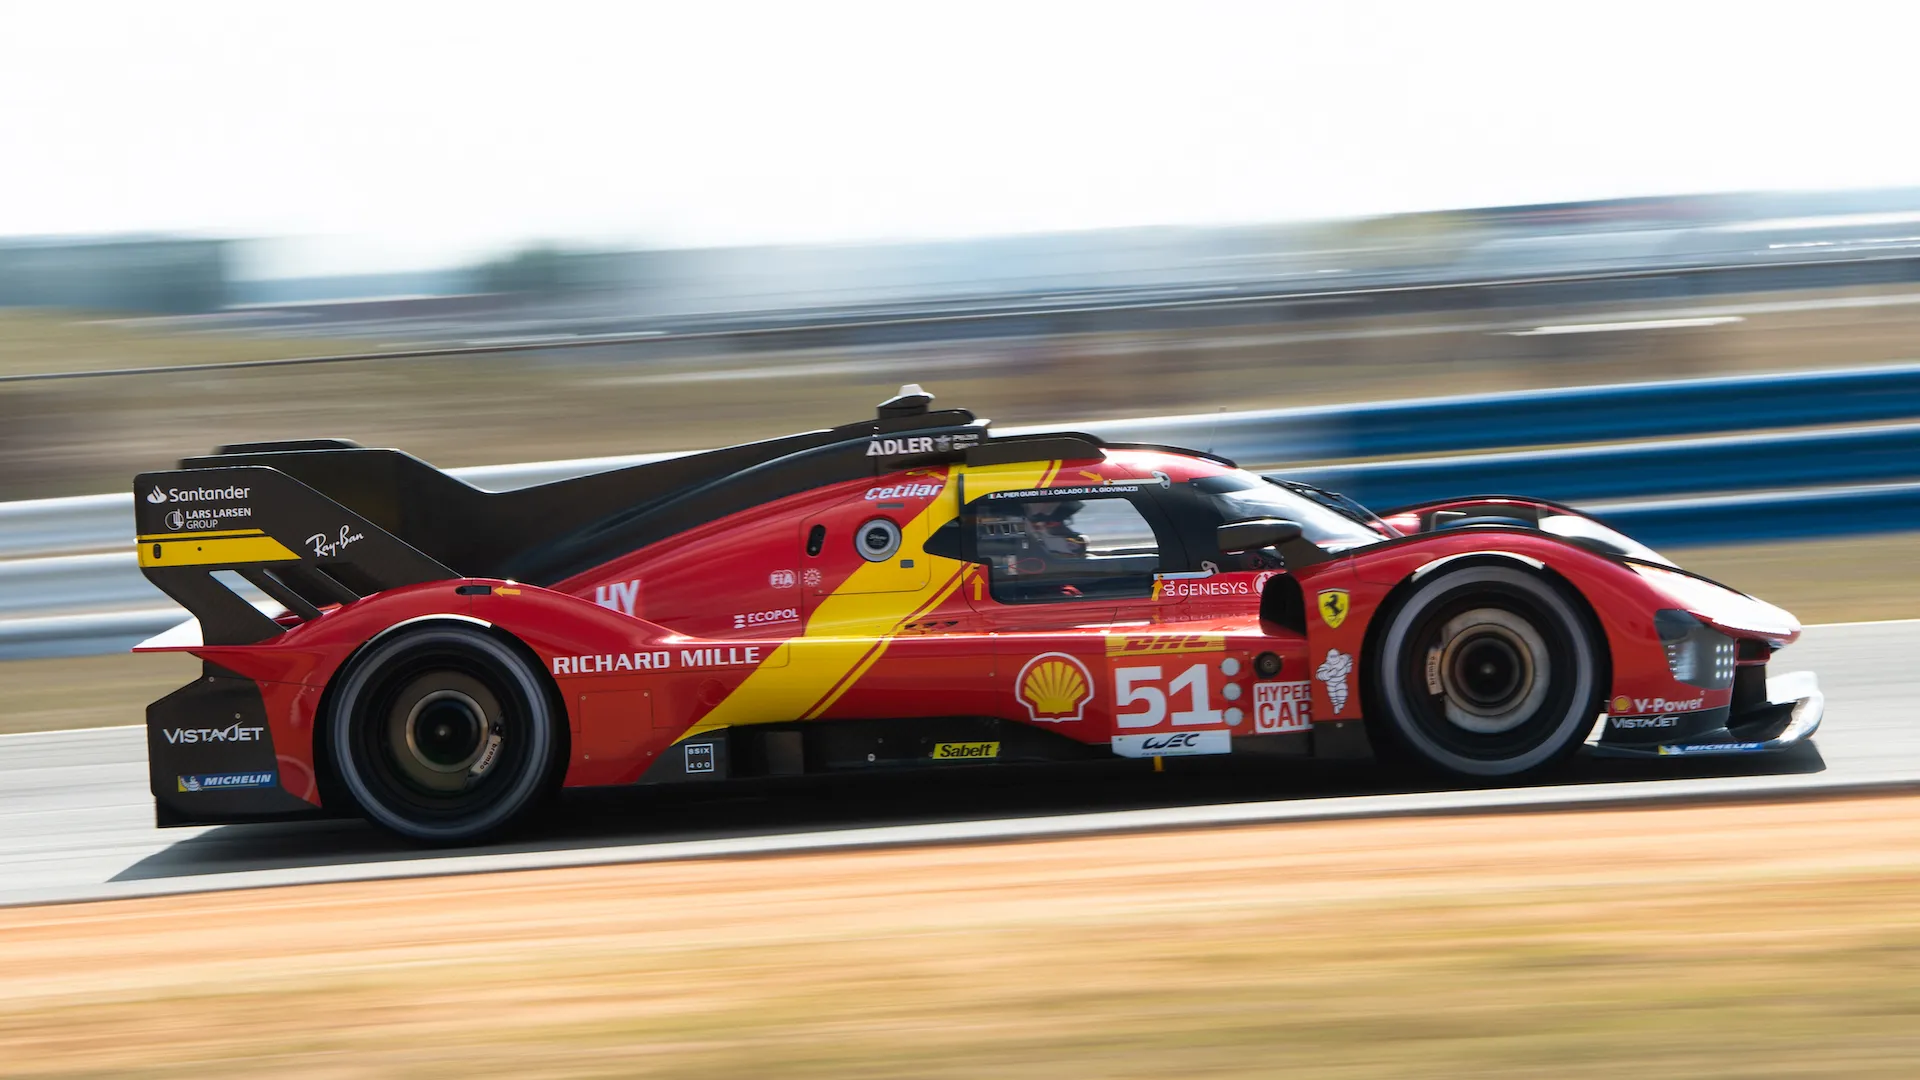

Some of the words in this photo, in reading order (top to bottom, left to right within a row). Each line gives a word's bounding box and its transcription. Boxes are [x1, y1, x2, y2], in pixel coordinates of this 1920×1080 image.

[866, 436, 934, 456] ADLER
[168, 485, 251, 503] Santander
[185, 509, 212, 519] LARS
[212, 507, 252, 518] LARSEN
[185, 519, 218, 530] GROUP
[1178, 582, 1249, 597] GENESYS
[747, 608, 799, 623] ECOPOL
[552, 651, 670, 675] RICHARD
[681, 646, 760, 668] MILLE
[1114, 663, 1224, 729] 51
[1633, 698, 1704, 713] V-Power
[1258, 700, 1312, 729] CAR
[1141, 733, 1200, 750] WEC
[1685, 742, 1758, 751] MICHELIN
[479, 743, 498, 770] brembo
[940, 743, 992, 758] Sabelt
[689, 761, 711, 769] 400
[203, 774, 272, 786] MICHELIN
